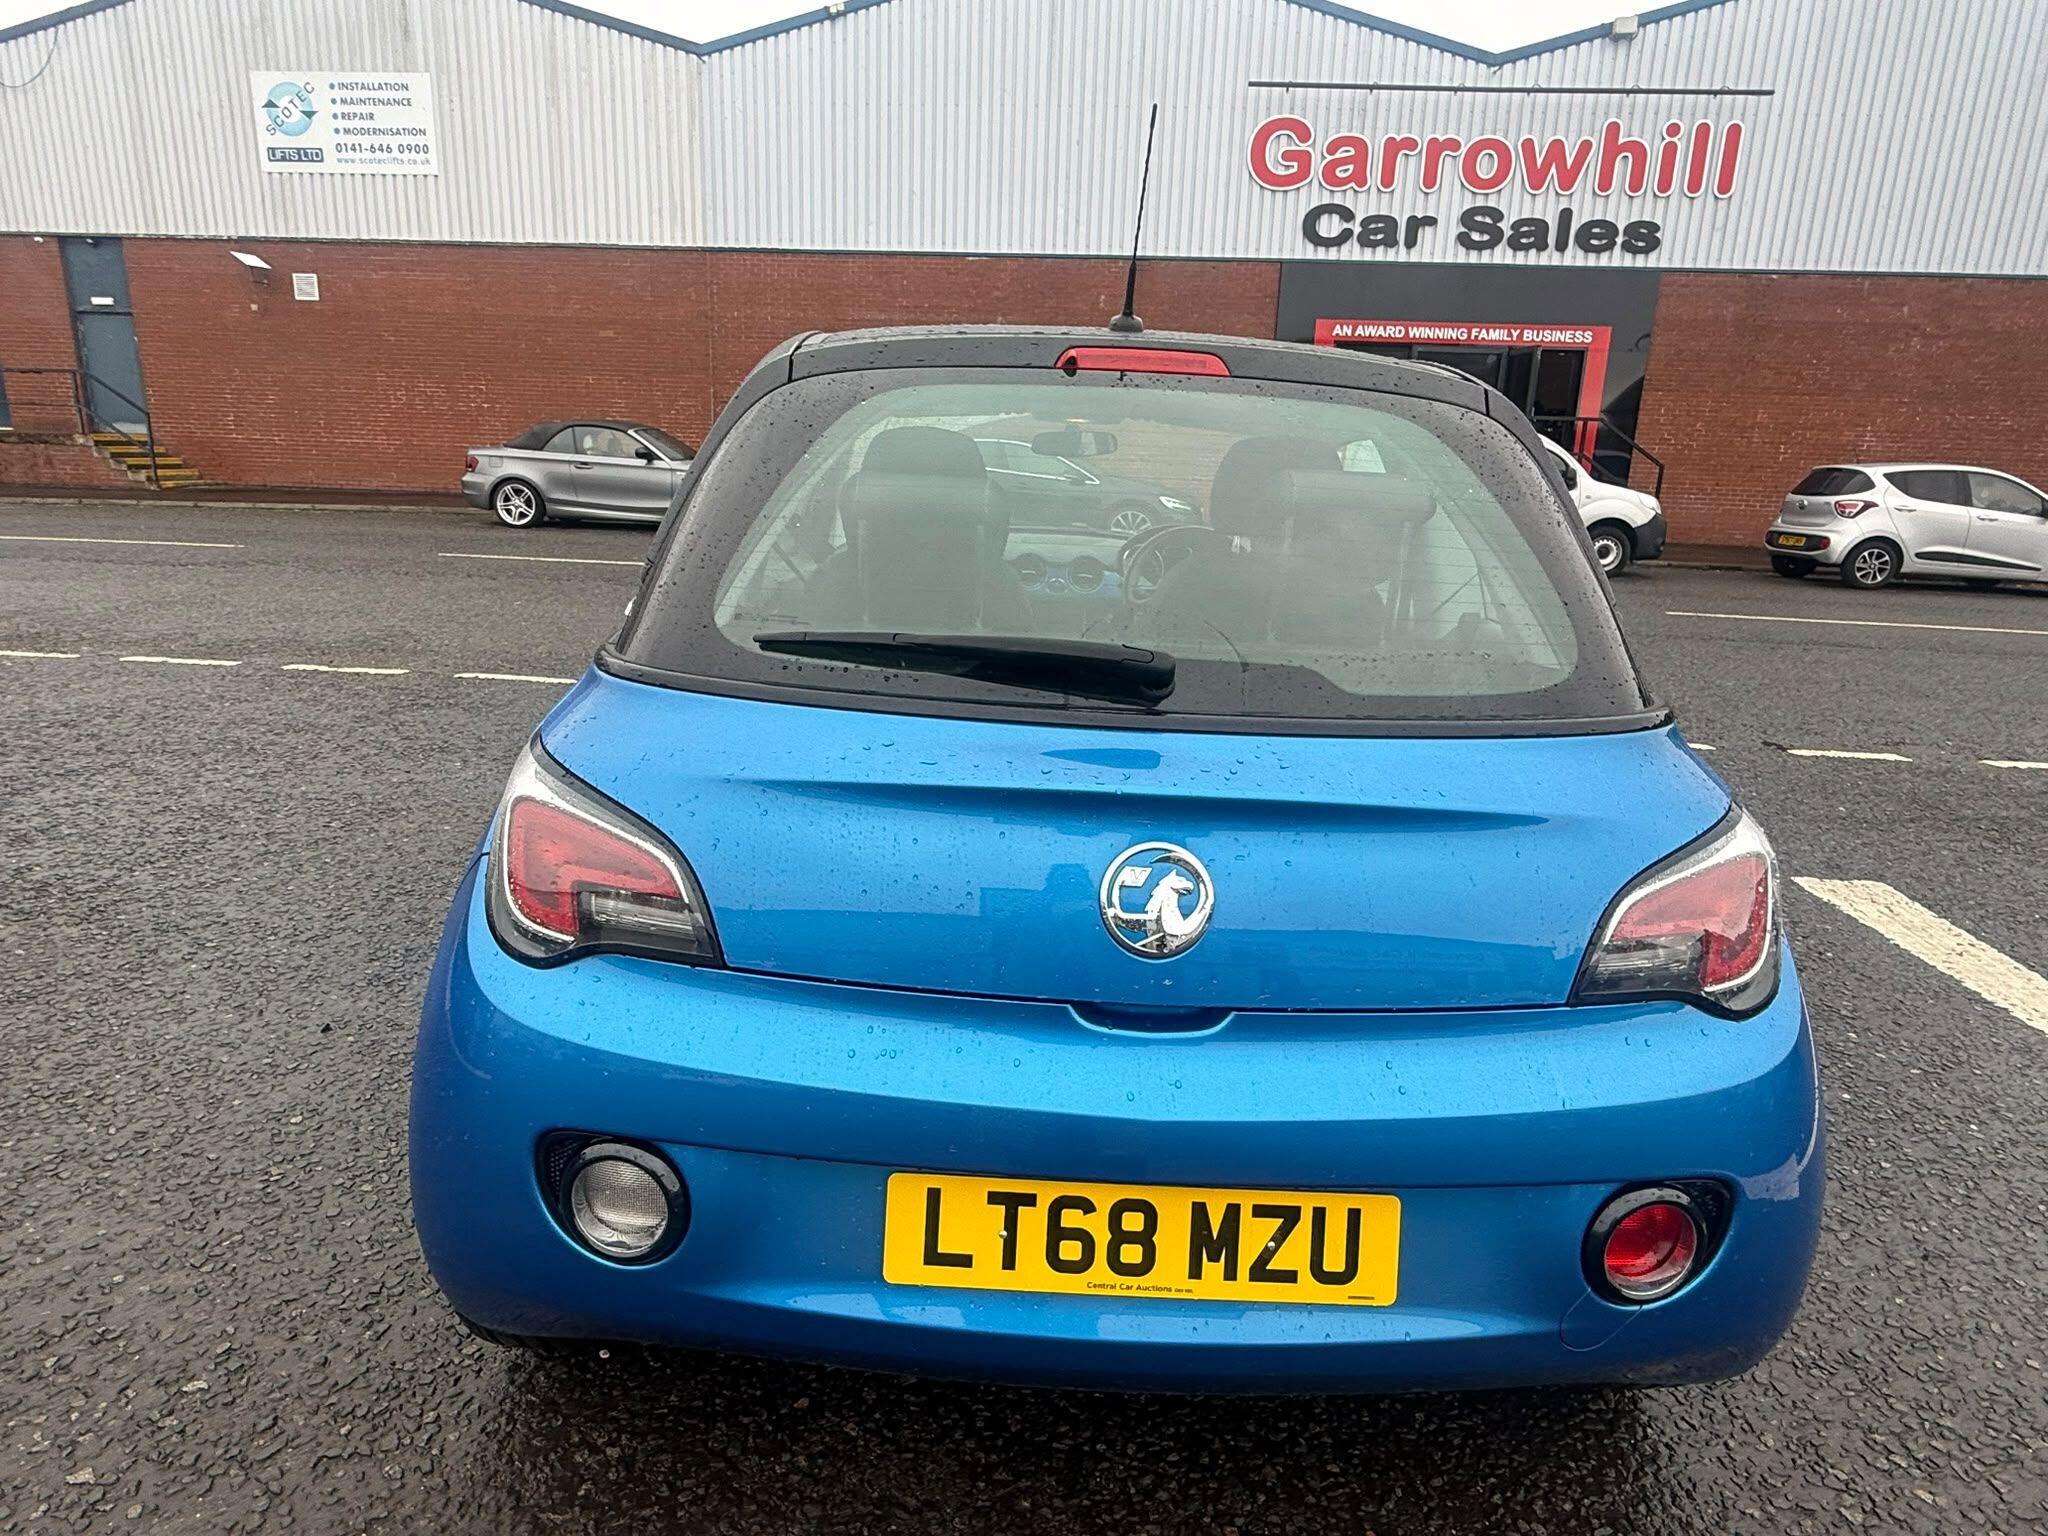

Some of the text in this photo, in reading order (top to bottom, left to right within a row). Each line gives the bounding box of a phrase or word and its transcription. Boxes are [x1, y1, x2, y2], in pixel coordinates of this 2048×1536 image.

[337, 82, 409, 92] INSTALLATION
[340, 97, 412, 107] MAINTENANCE
[266, 81, 315, 136] SCOTEC
[341, 112, 375, 121] REPAIR
[343, 127, 427, 137] MODERNISATION
[269, 149, 322, 161] LIFTS LTD
[335, 143, 429, 155] 0141-646 0900
[1247, 114, 1746, 199] Garrowhill
[1301, 203, 1662, 255] Car Sales
[1332, 324, 1593, 343] AN AWARD WINNING FAMILY BUSINESS
[922, 1187, 1362, 1286] LT68 MZU
[1086, 1281, 1116, 1290] Central
[1119, 1283, 1133, 1291] Car
[1135, 1284, 1172, 1293] Auctions
